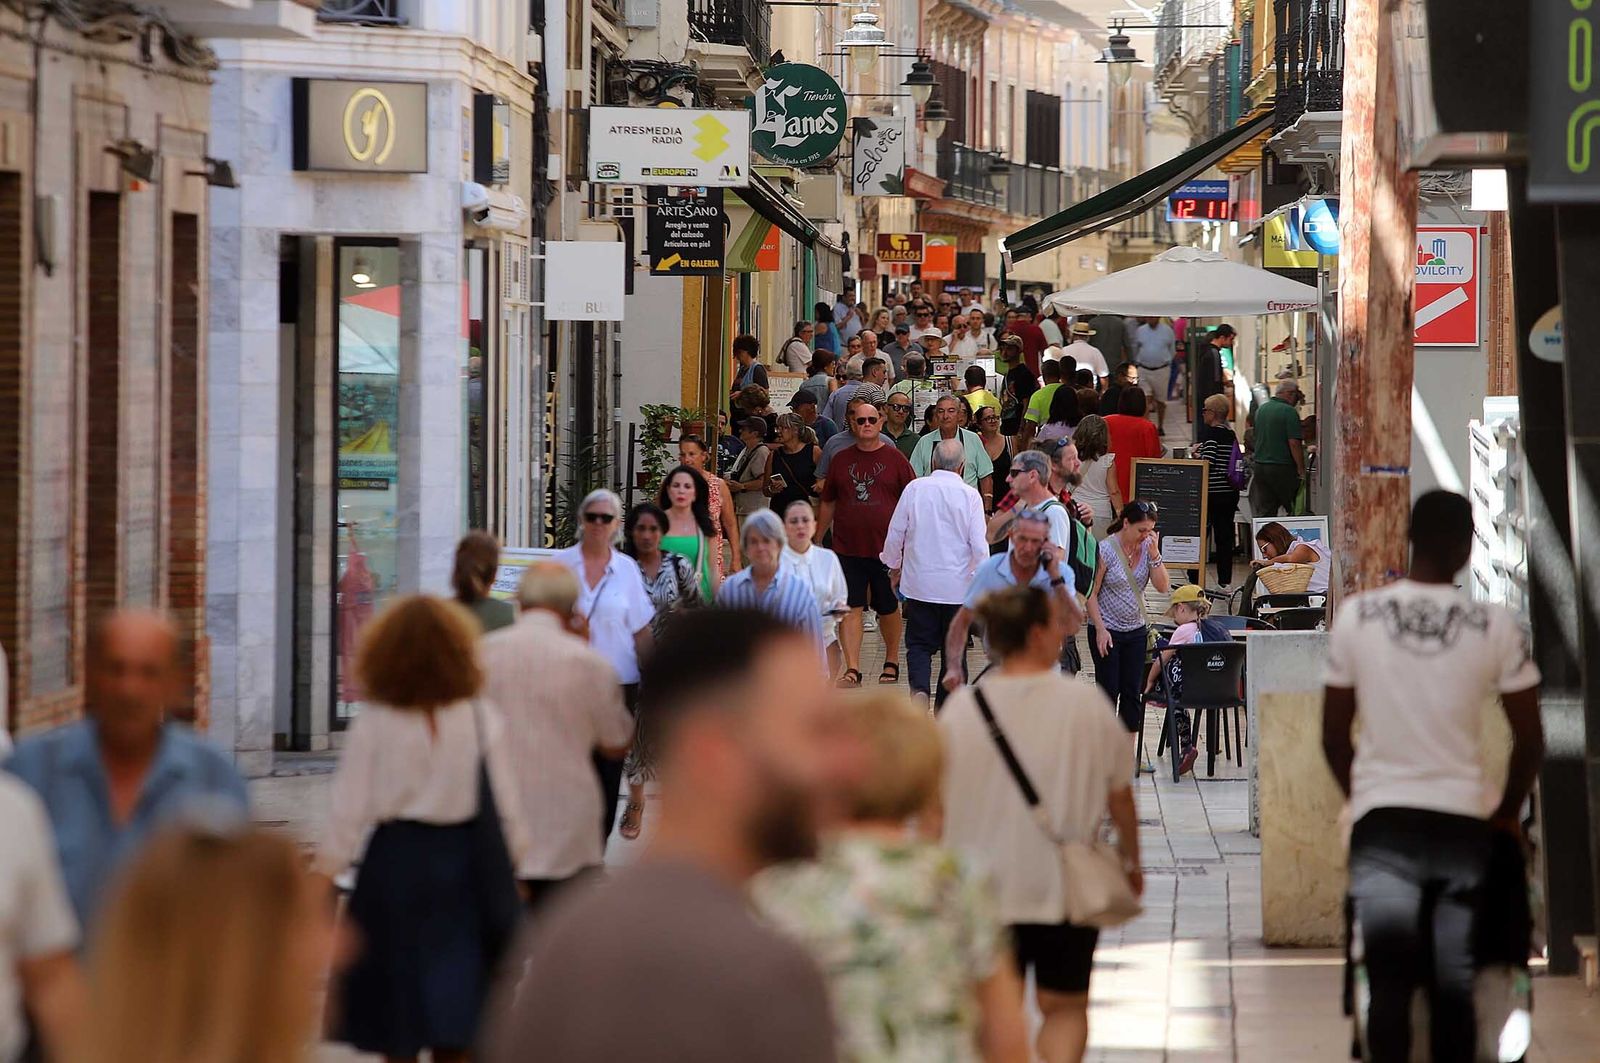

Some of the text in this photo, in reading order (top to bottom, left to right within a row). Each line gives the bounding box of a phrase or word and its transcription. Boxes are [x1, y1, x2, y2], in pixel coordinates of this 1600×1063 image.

[803, 89, 836, 101] Tiendas
[608, 126, 682, 136] ATRESMEDIA
[652, 136, 683, 144] RADIO
[657, 197, 670, 206] EL
[656, 205, 718, 218] ARTESANO
[1177, 199, 1196, 219] 12
[665, 221, 687, 230] Arreglo
[670, 230, 704, 238] del calzado
[698, 240, 711, 249] piel
[878, 250, 921, 260] TABACOS
